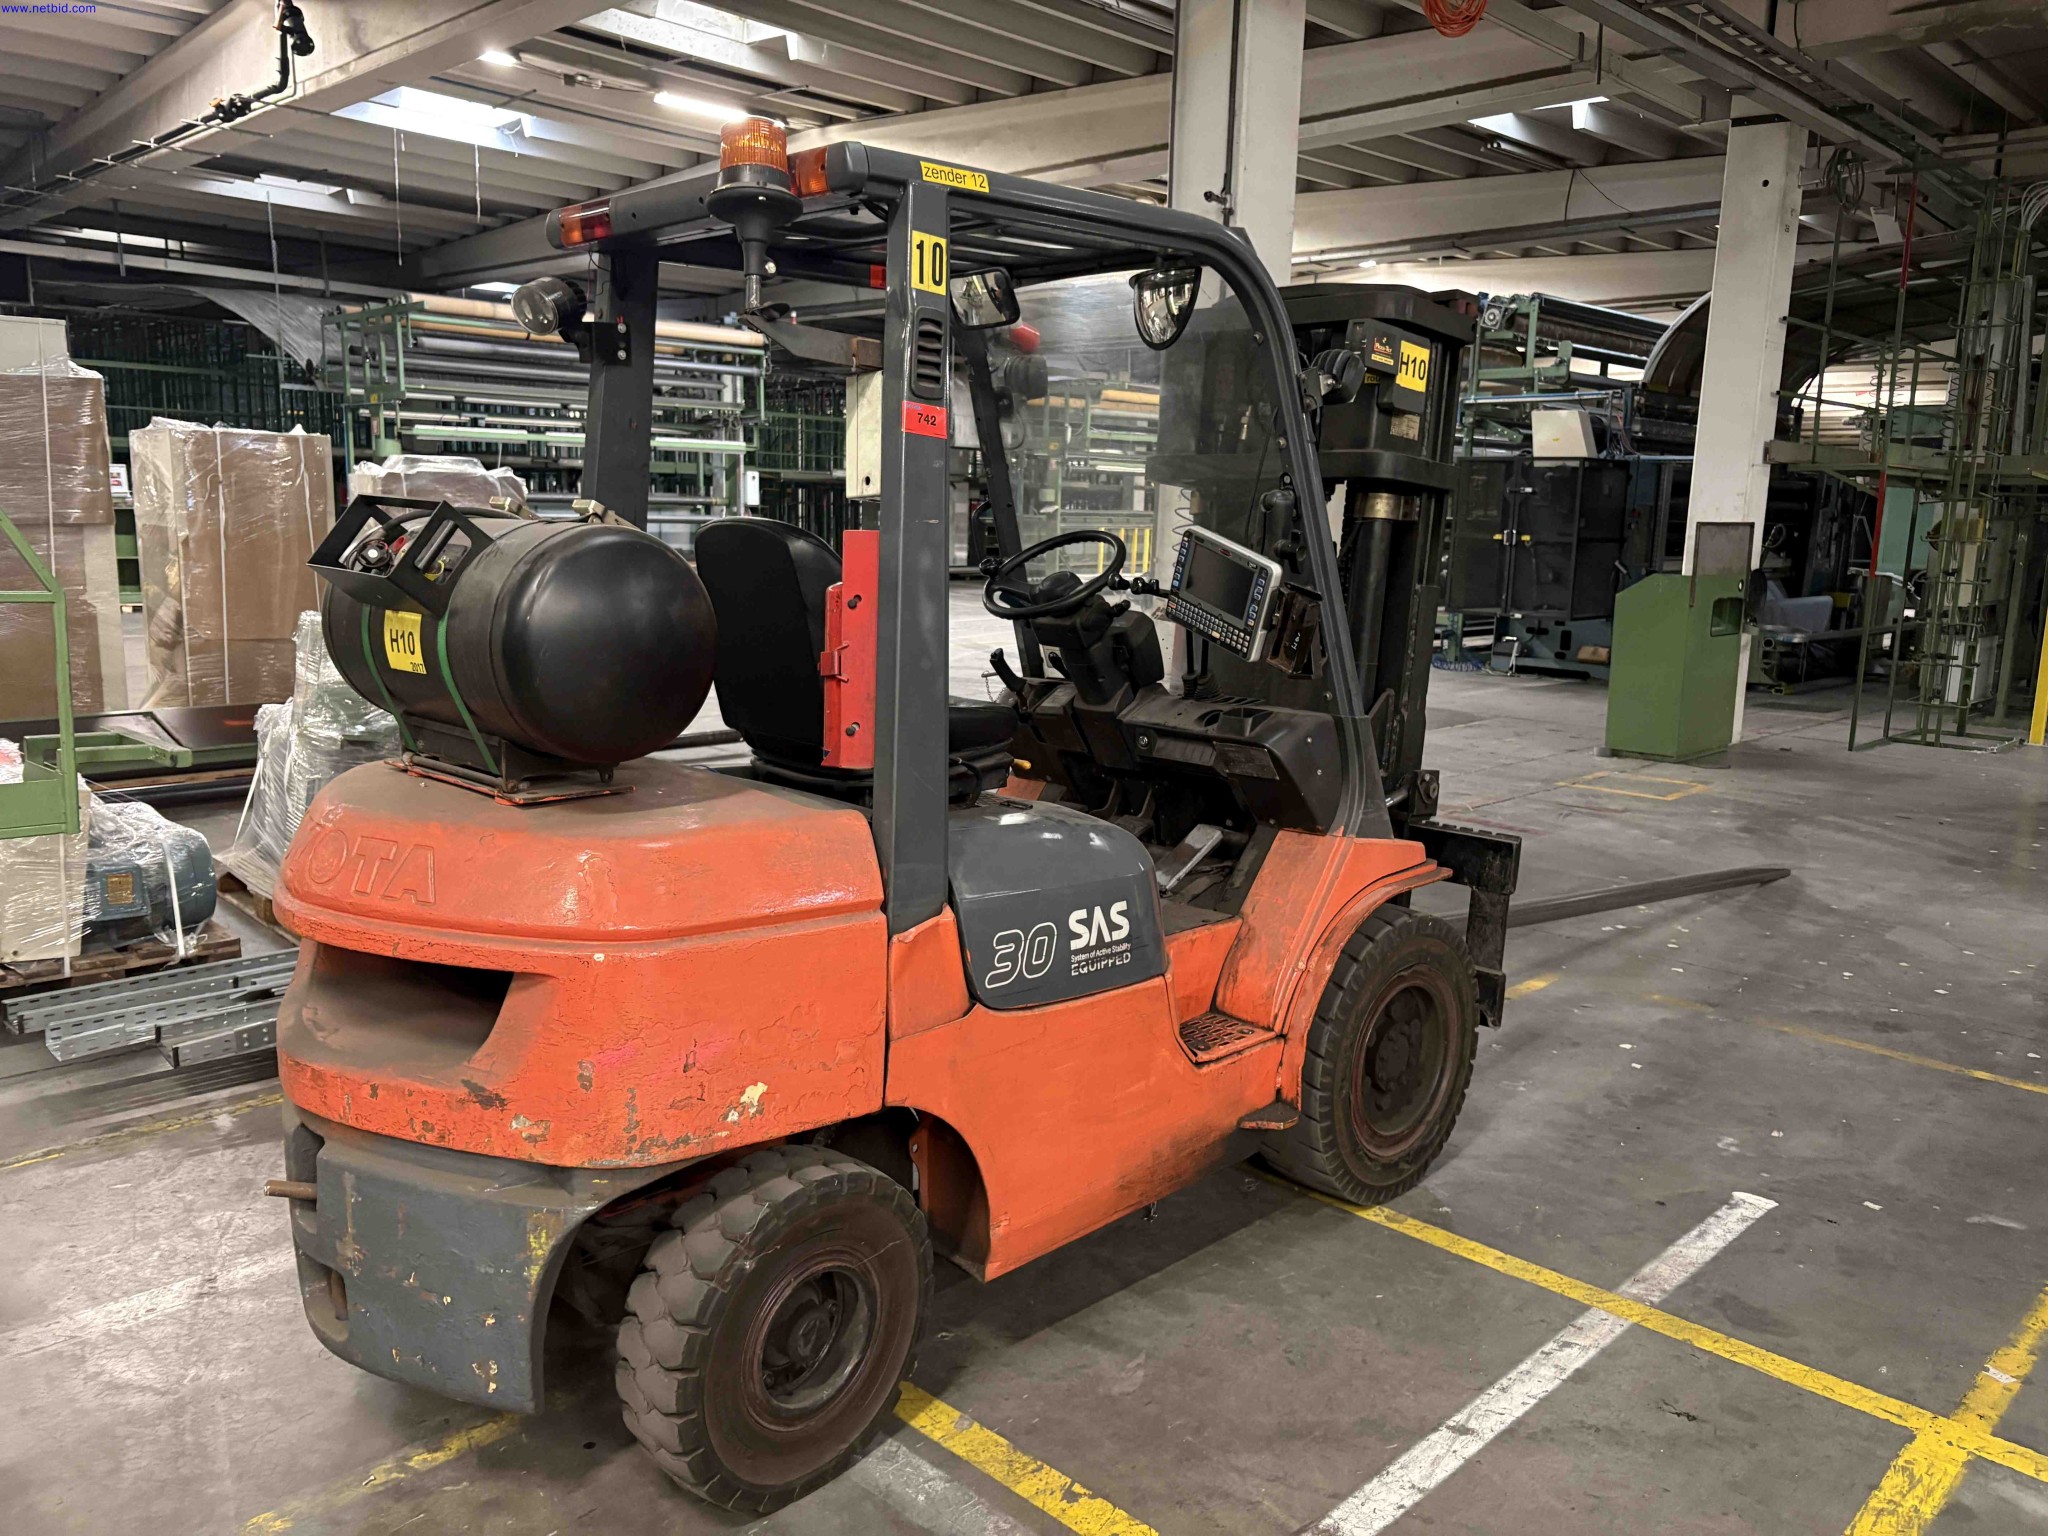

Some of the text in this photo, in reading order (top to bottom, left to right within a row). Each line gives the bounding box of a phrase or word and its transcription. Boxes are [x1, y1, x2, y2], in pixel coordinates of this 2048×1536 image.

[924, 166, 987, 189] zender 12
[916, 239, 944, 287] 10
[1399, 351, 1427, 381] H10
[917, 412, 937, 427] 742
[389, 628, 416, 656] H10
[1068, 900, 1130, 951] SAS
[984, 921, 1058, 989] 30
[1070, 942, 1132, 964] System of Active Stability
[1071, 952, 1131, 976] EQUIPPED
